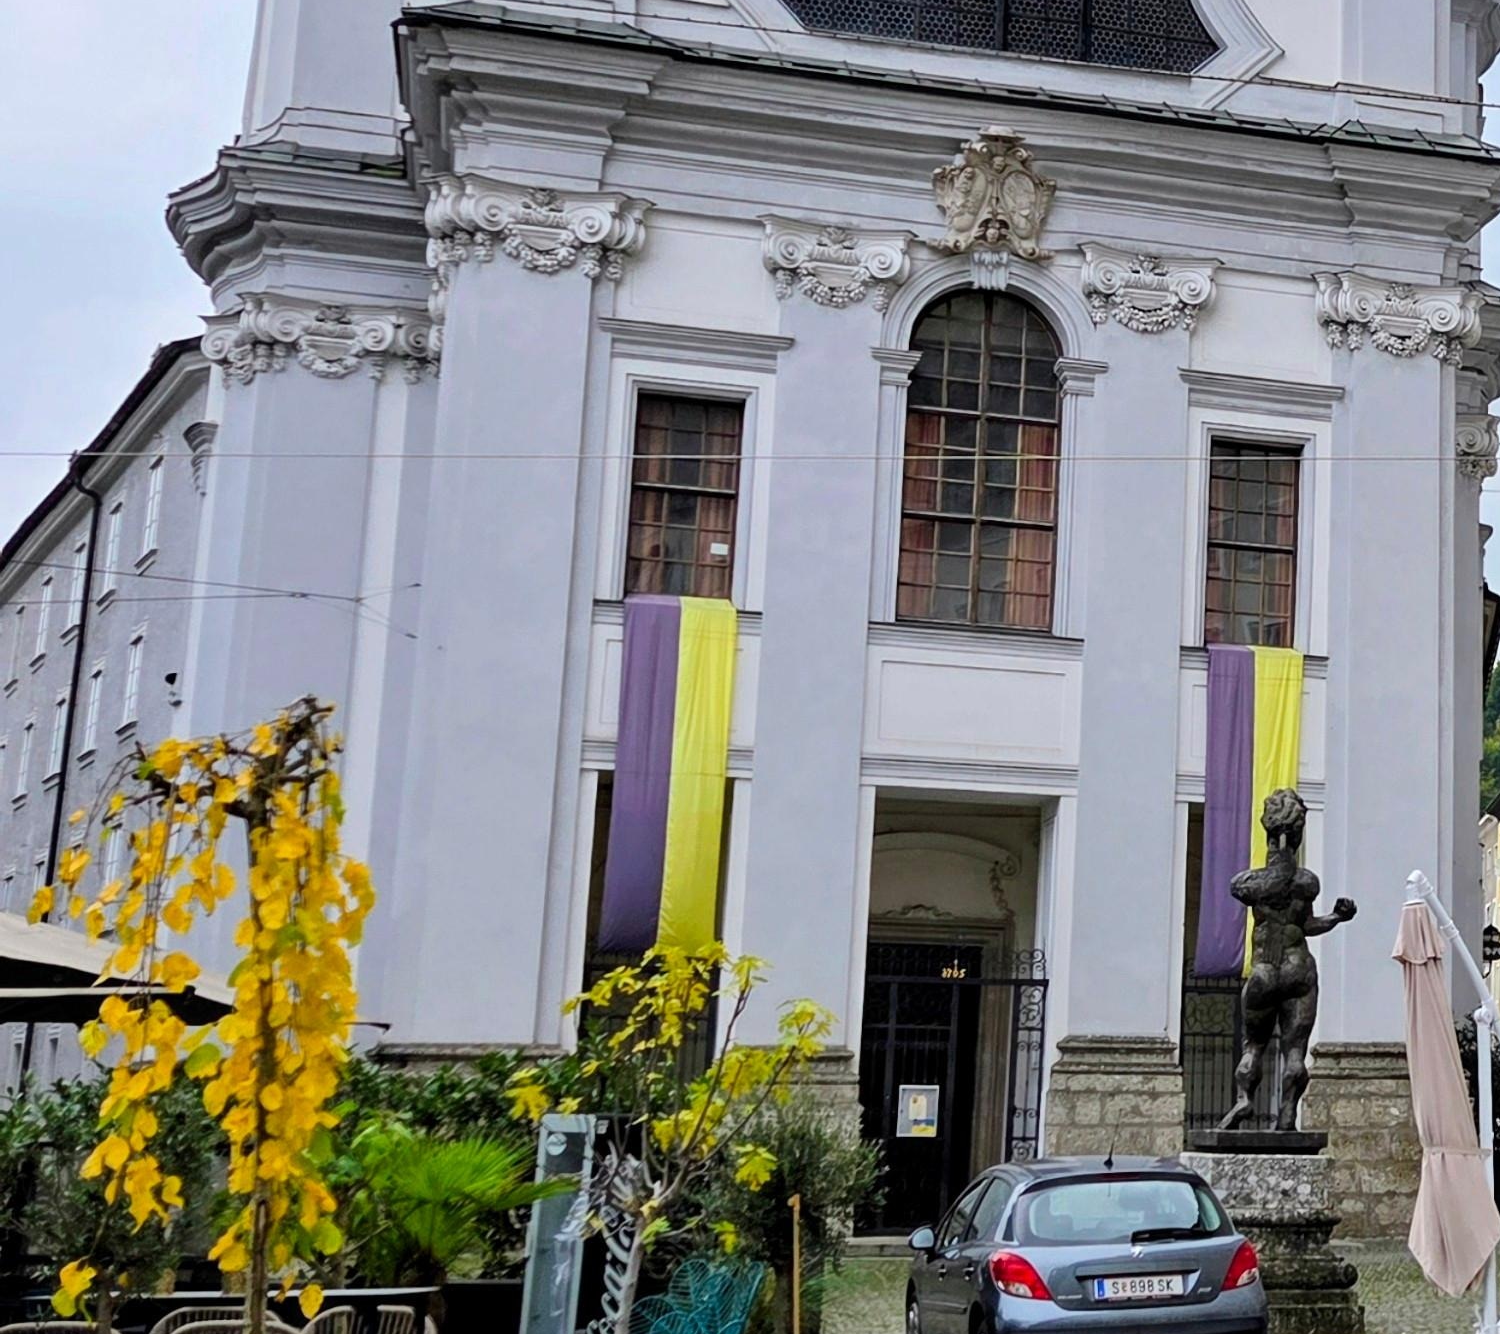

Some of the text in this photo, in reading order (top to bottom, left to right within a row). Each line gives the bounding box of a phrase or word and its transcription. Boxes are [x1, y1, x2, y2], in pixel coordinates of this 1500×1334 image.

[1112, 1278, 1175, 1295] S 898 SK
